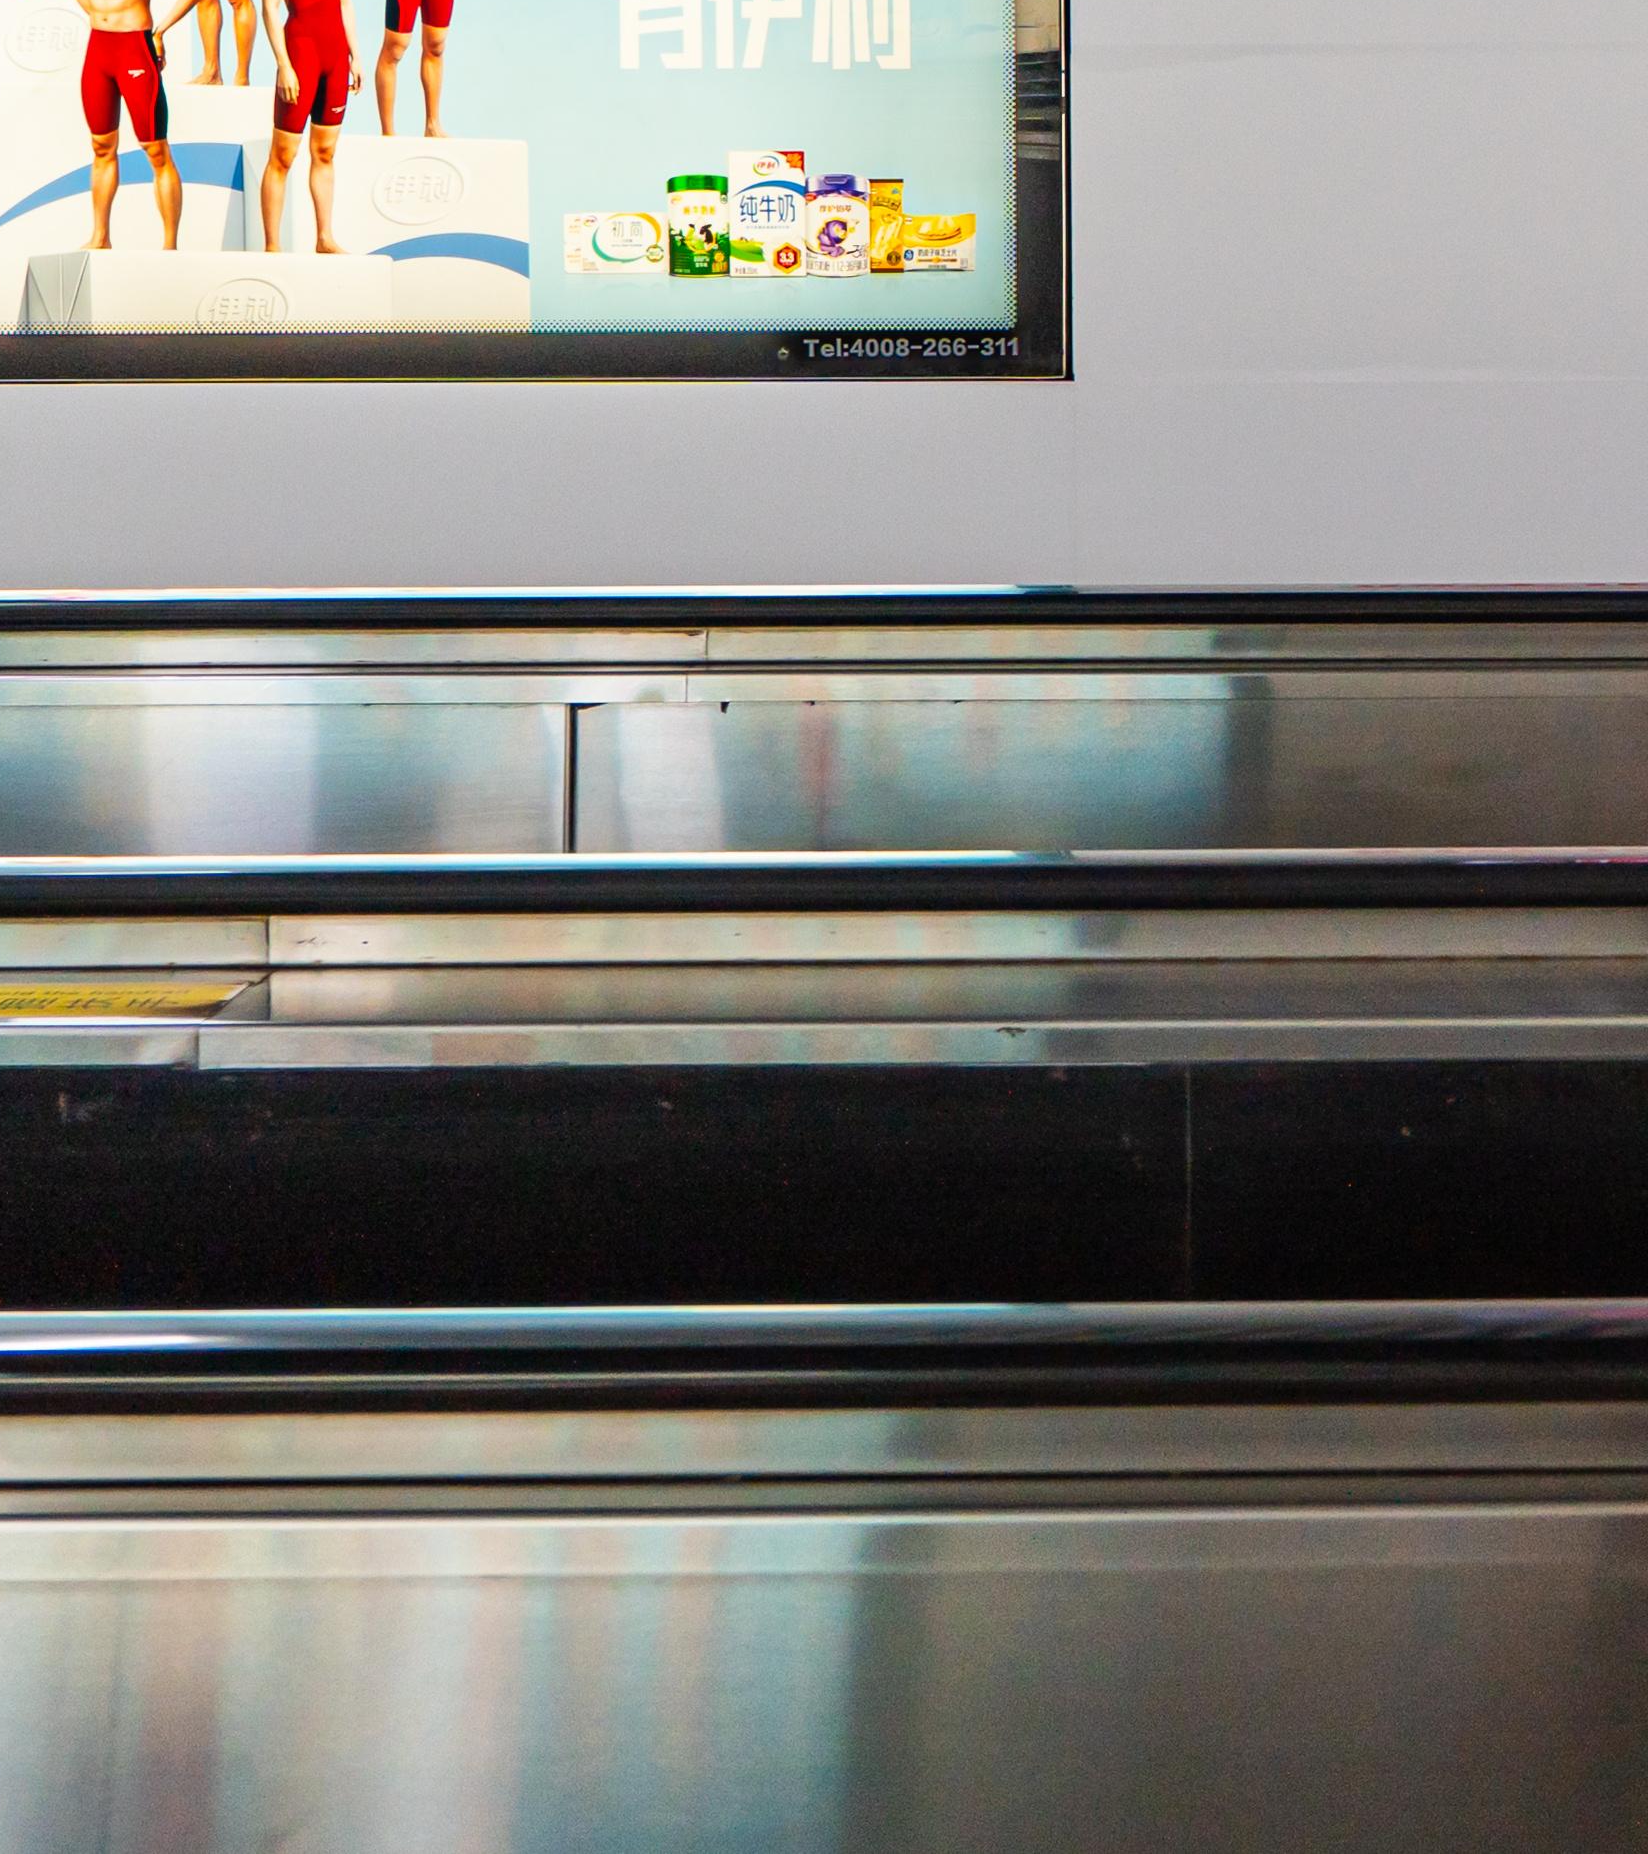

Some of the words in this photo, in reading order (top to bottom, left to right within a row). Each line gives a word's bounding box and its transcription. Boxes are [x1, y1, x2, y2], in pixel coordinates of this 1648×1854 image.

[739, 193, 796, 224] 纯牛奶
[802, 337, 1021, 359] Tel:4008-266-311
